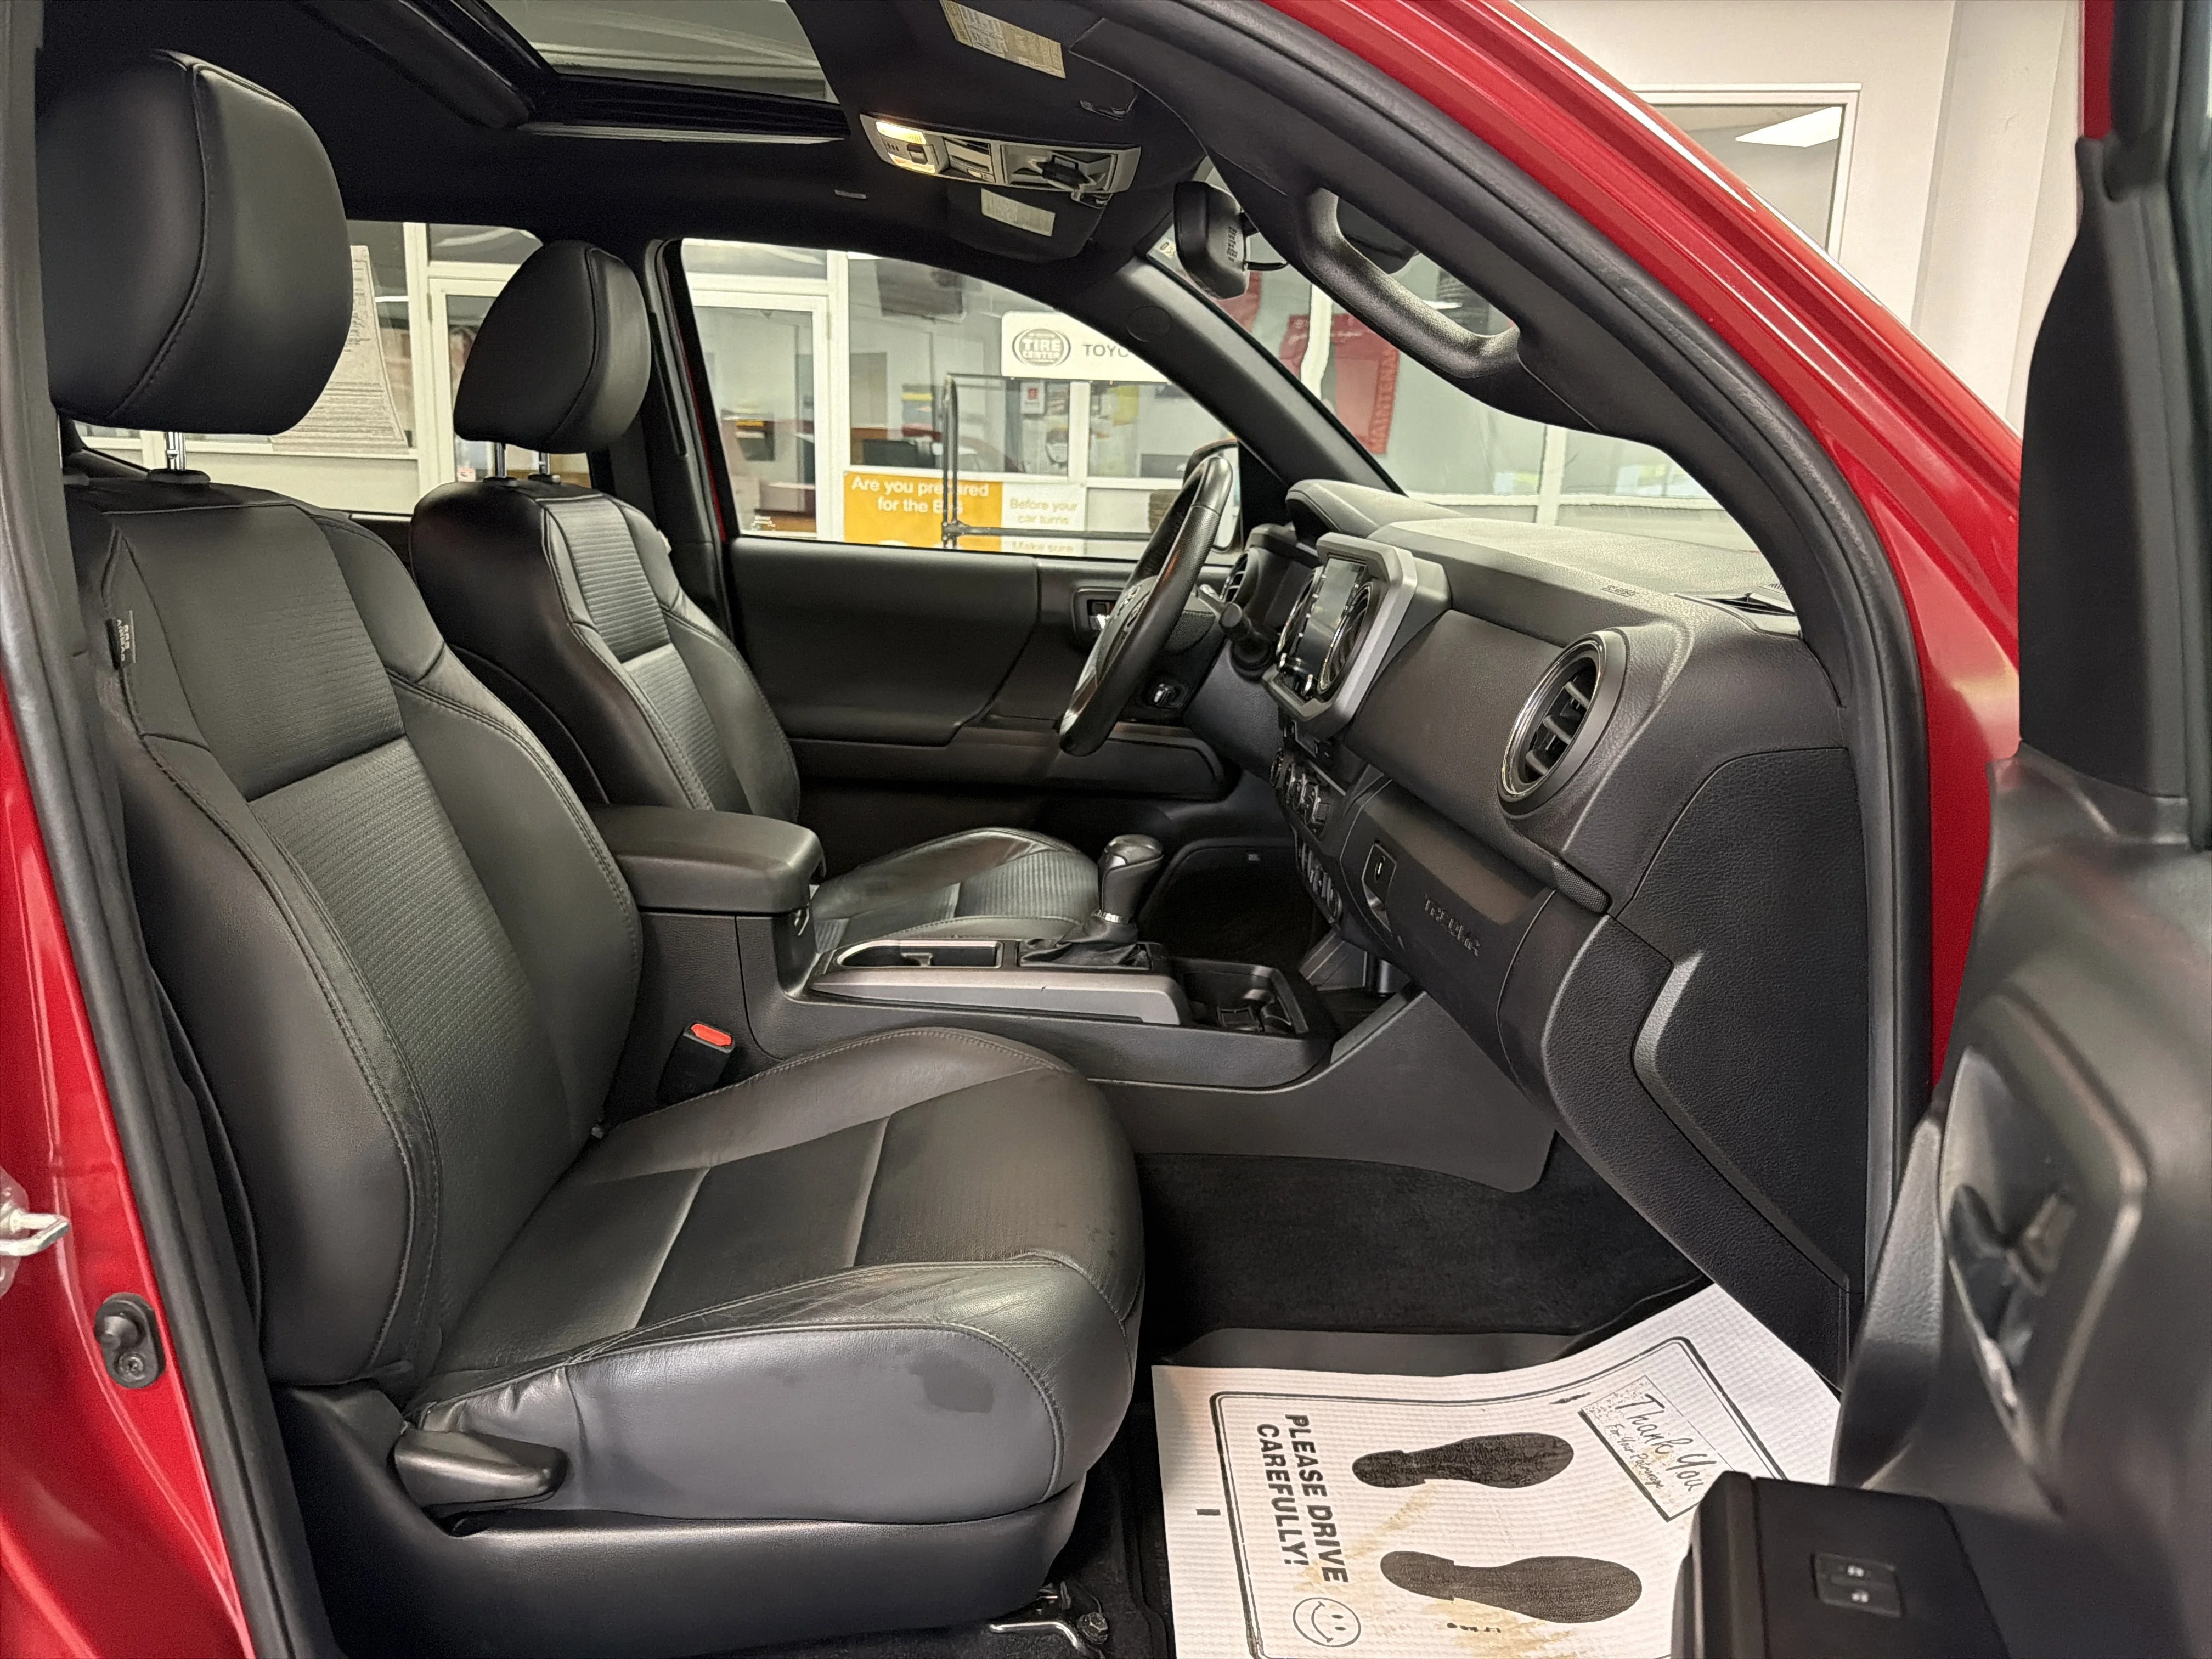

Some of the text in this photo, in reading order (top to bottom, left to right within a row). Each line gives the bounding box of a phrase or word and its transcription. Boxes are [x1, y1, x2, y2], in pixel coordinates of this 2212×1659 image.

[1022, 338, 1060, 352] TIRE
[851, 476, 989, 497] Are you preared
[878, 495, 900, 511] for
[903, 499, 928, 512] the
[1010, 498, 1078, 512] Before your
[1017, 515, 1037, 523] car
[1605, 1423, 1625, 1436] For
[1617, 1436, 1636, 1453] Your
[1615, 1393, 1717, 1492] Thank You
[1257, 1424, 1309, 1566] CAREFULLY!
[1285, 1414, 1349, 1583] PLEASE DRIVE
